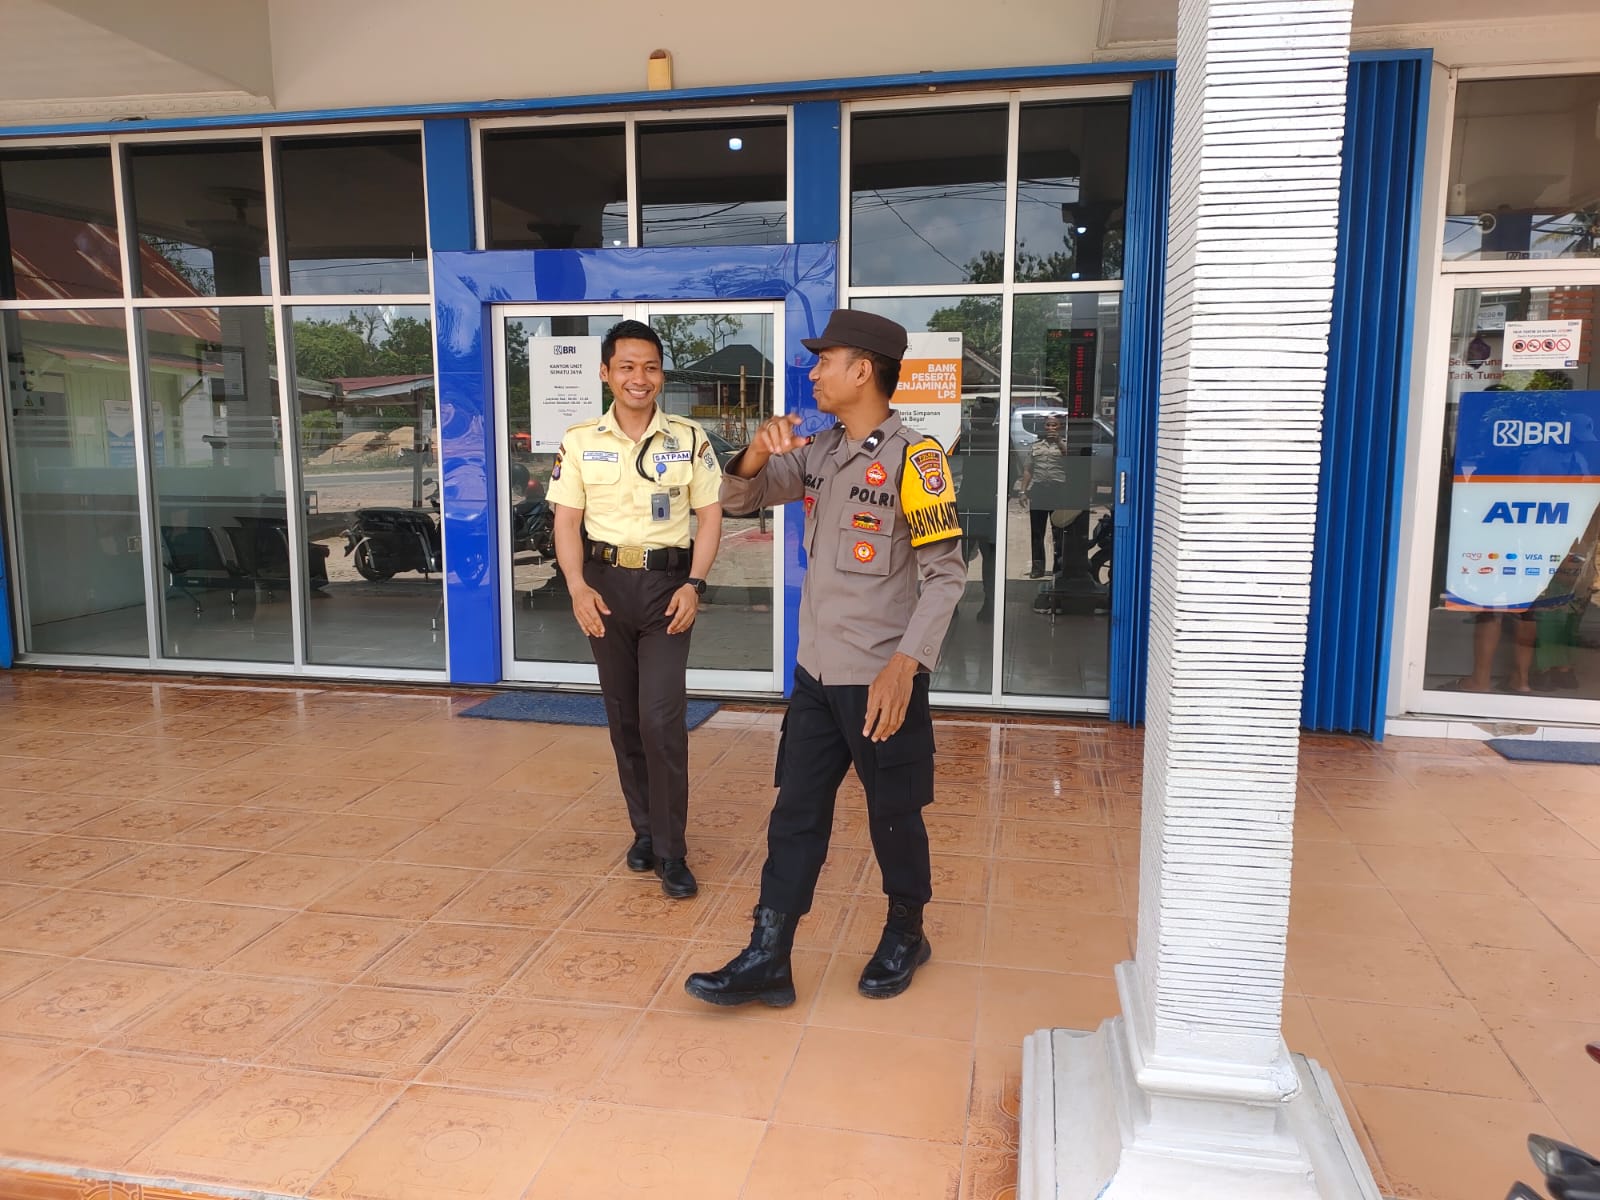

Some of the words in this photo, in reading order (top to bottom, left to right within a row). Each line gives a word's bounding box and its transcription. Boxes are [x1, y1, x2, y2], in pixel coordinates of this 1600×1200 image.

[563, 346, 576, 354] BRI
[928, 363, 957, 372] BANK
[911, 373, 957, 382] PESERTA
[1449, 371, 1473, 380] Tarik
[897, 381, 957, 391] ENJAMINAN
[937, 390, 957, 399] LPS
[1524, 422, 1571, 445] BRI
[655, 453, 689, 461] SATPAM
[850, 486, 895, 507] POLRI
[1481, 502, 1570, 524] ATM
[1525, 553, 1543, 561] VISA
